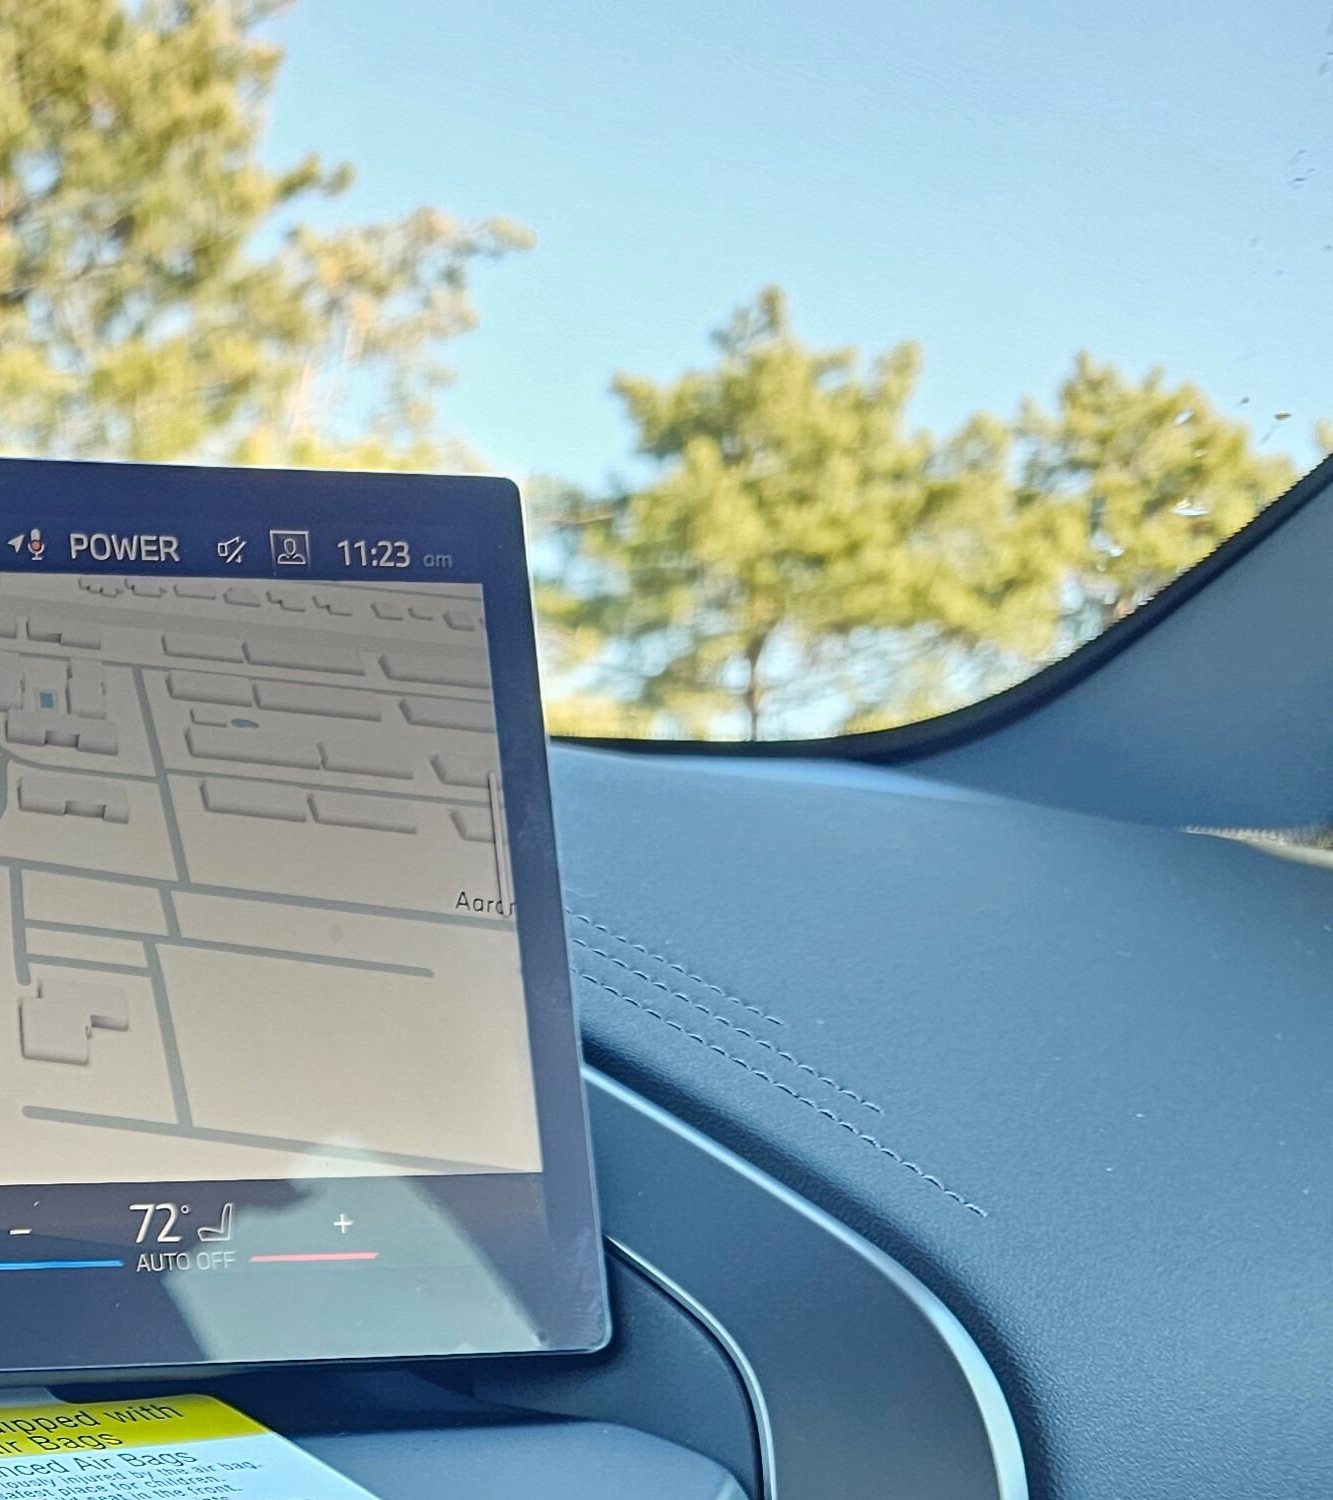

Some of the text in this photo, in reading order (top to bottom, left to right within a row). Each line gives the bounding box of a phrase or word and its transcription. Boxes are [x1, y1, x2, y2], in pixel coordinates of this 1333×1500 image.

[69, 532, 181, 562] POWER
[337, 540, 453, 568] 11:23 am
[129, 1202, 191, 1244] 72°
[136, 1250, 237, 1273] AUTO OFF
[104, 1403, 183, 1424] with
[28, 1430, 124, 1451] Bags
[58, 1471, 128, 1486] injured
[128, 1470, 155, 1482] by
[156, 1465, 189, 1478] the
[191, 1463, 218, 1474] air
[218, 1459, 263, 1471] bag.
[72, 1456, 116, 1472] Air
[117, 1451, 198, 1468] Bags
[57, 1484, 108, 1498] place
[109, 1481, 140, 1491] for
[144, 1473, 227, 1488] children.
[129, 1490, 152, 1500] in
[153, 1488, 187, 1499] the
[187, 1483, 243, 1496] front.
